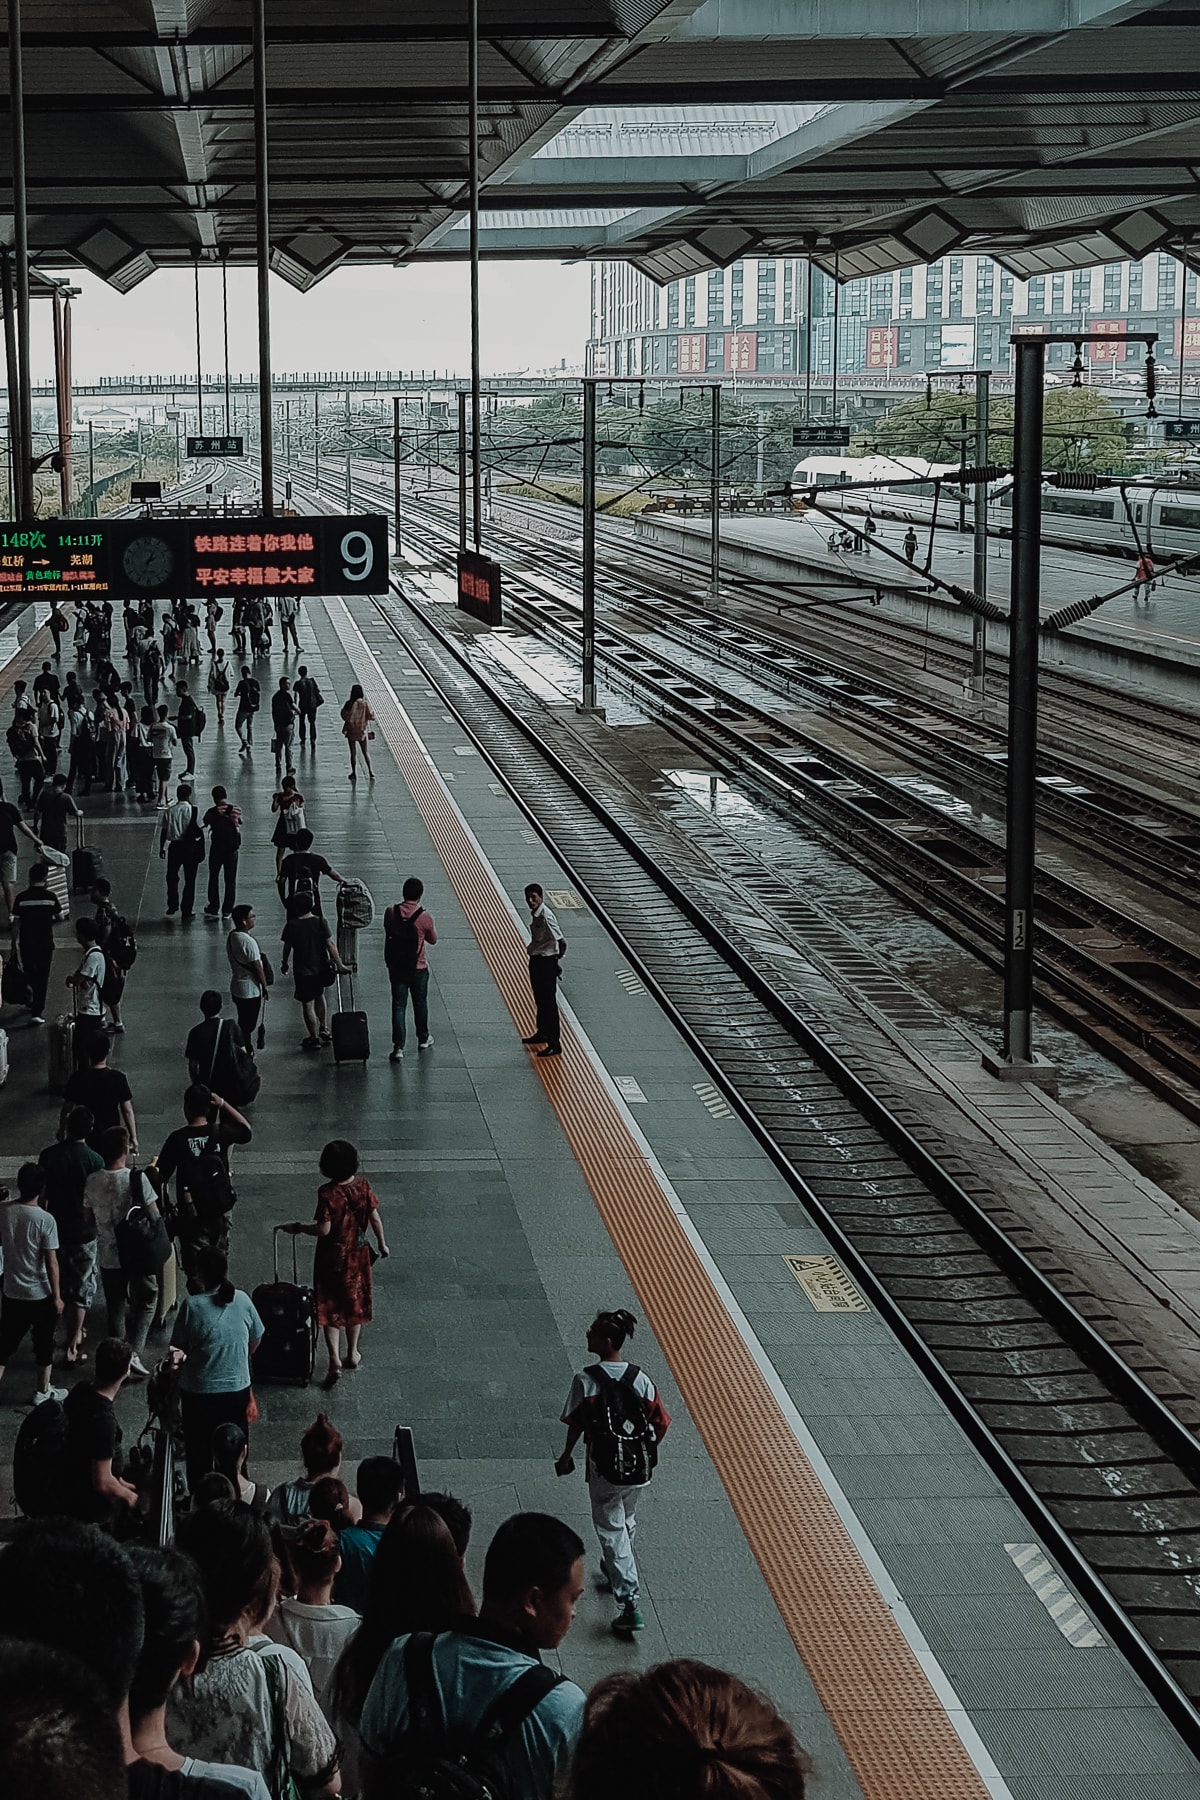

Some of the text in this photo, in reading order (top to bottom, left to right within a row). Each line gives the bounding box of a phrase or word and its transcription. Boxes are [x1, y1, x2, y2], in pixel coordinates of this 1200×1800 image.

[194, 439, 238, 450] 苏州站
[58, 533, 103, 547] 14:11开
[193, 533, 315, 553] 铁路连着你我他
[69, 553, 94, 566] 芜湖
[340, 530, 374, 582] 9
[195, 566, 315, 587] 平安幸福靠大家
[1014, 911, 1024, 947] 112
